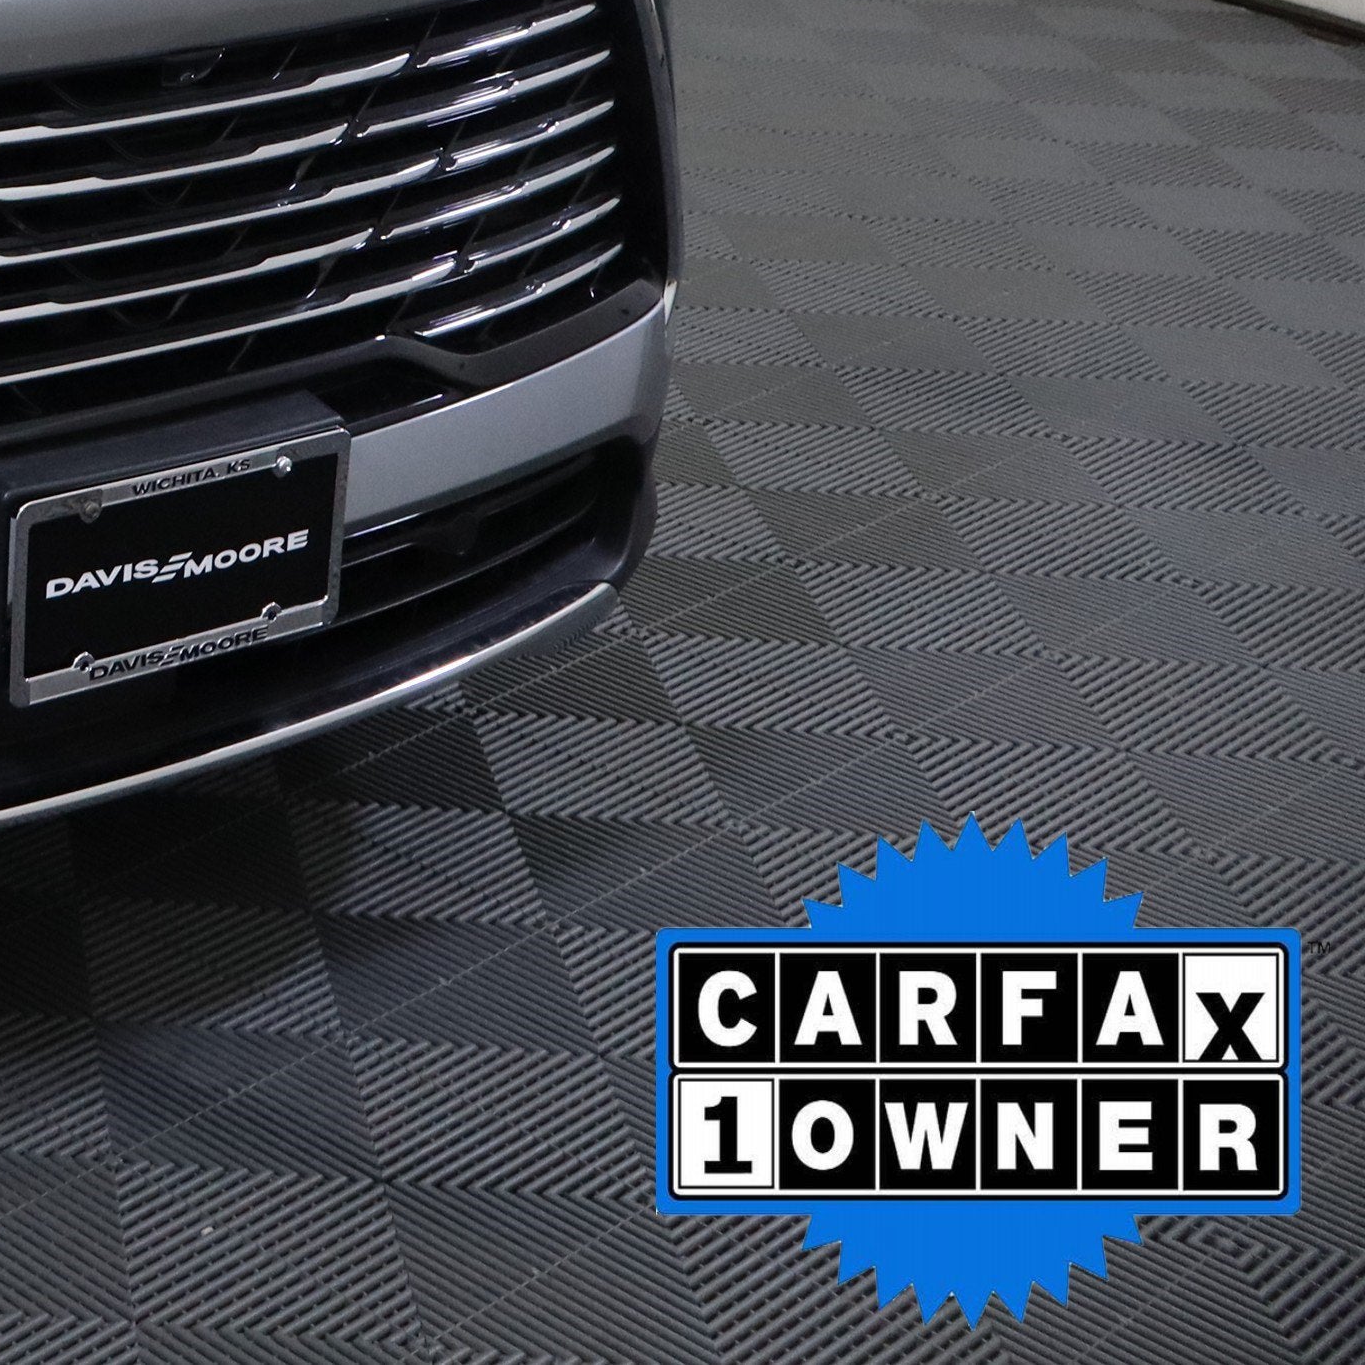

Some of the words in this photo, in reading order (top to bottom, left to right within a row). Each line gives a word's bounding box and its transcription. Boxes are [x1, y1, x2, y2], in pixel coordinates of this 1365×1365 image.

[226, 458, 252, 476] KS
[45, 559, 159, 599] DAVIS
[183, 529, 309, 579] MOORE
[88, 649, 169, 682] DAVIS
[179, 626, 269, 664] MOORE
